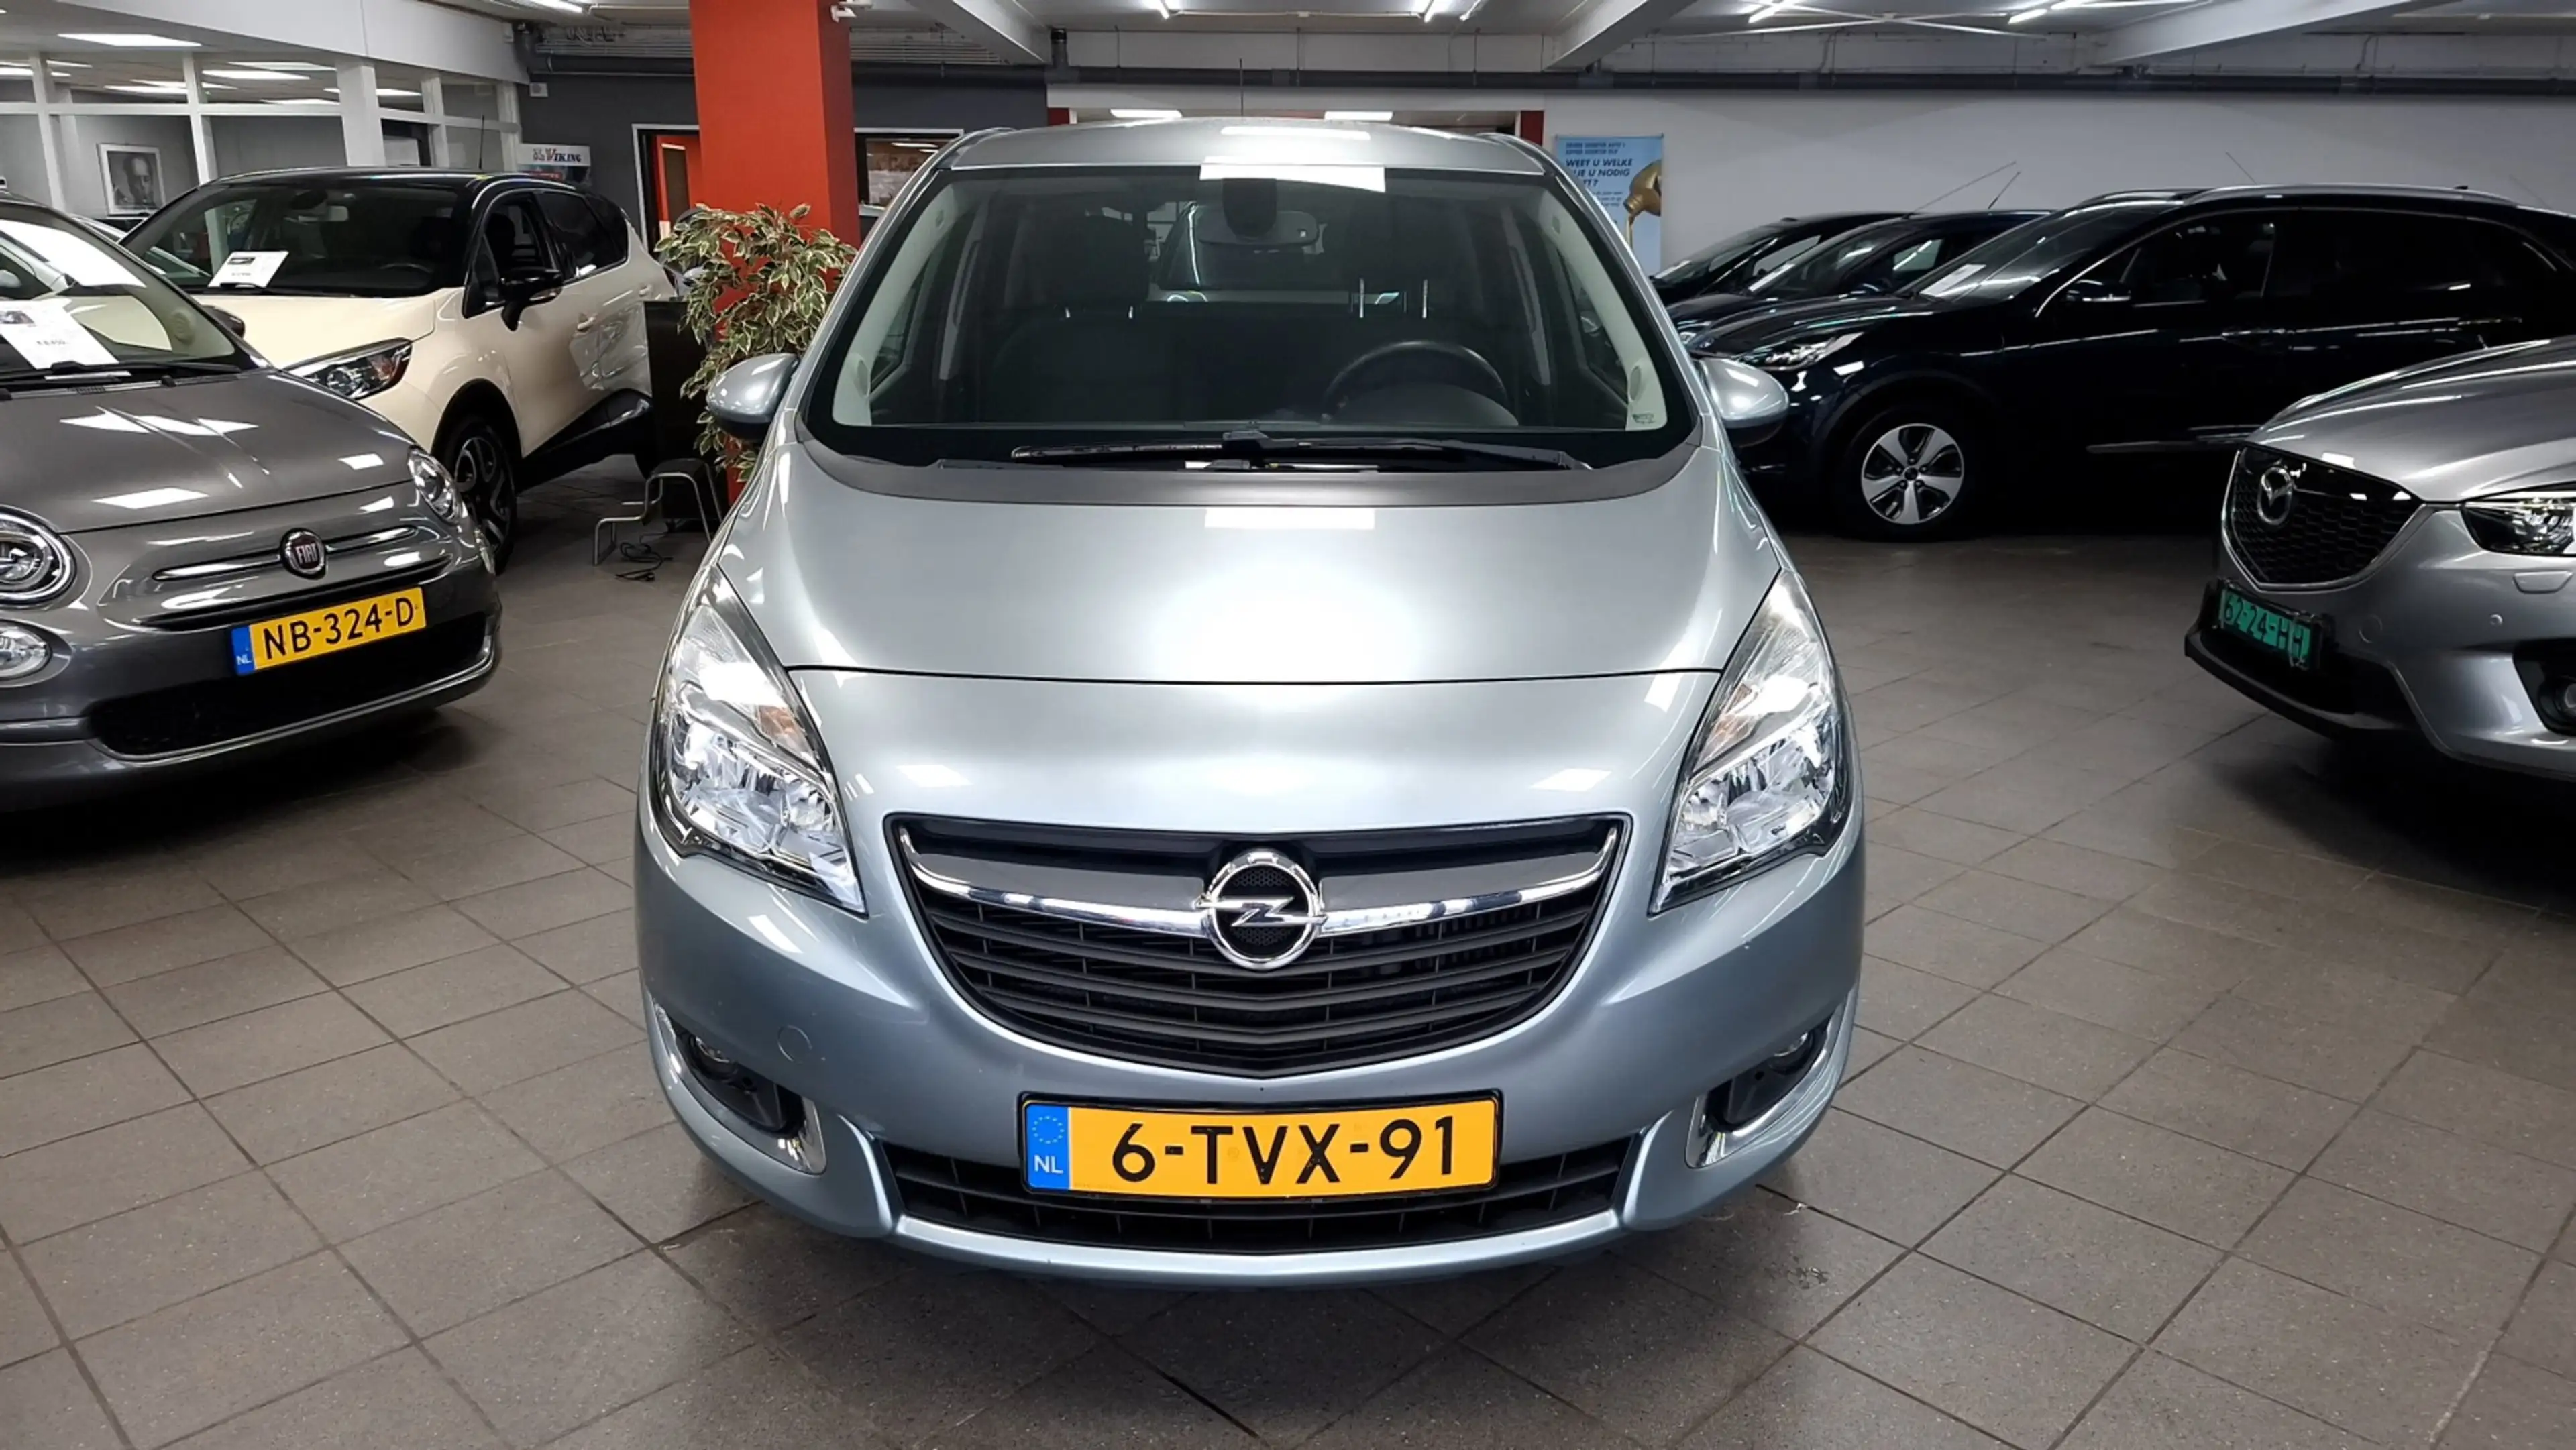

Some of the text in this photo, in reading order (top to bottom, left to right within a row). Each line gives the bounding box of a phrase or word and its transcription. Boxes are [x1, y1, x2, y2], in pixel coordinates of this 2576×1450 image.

[1566, 158, 1591, 167] WEET
[1602, 158, 1633, 166] WELKE
[1598, 168, 1630, 176] NODIG
[295, 543, 317, 564] FIAT
[237, 597, 414, 665] NL NB-324-D
[1034, 1115, 1453, 1185] NL 6-TVX-91
